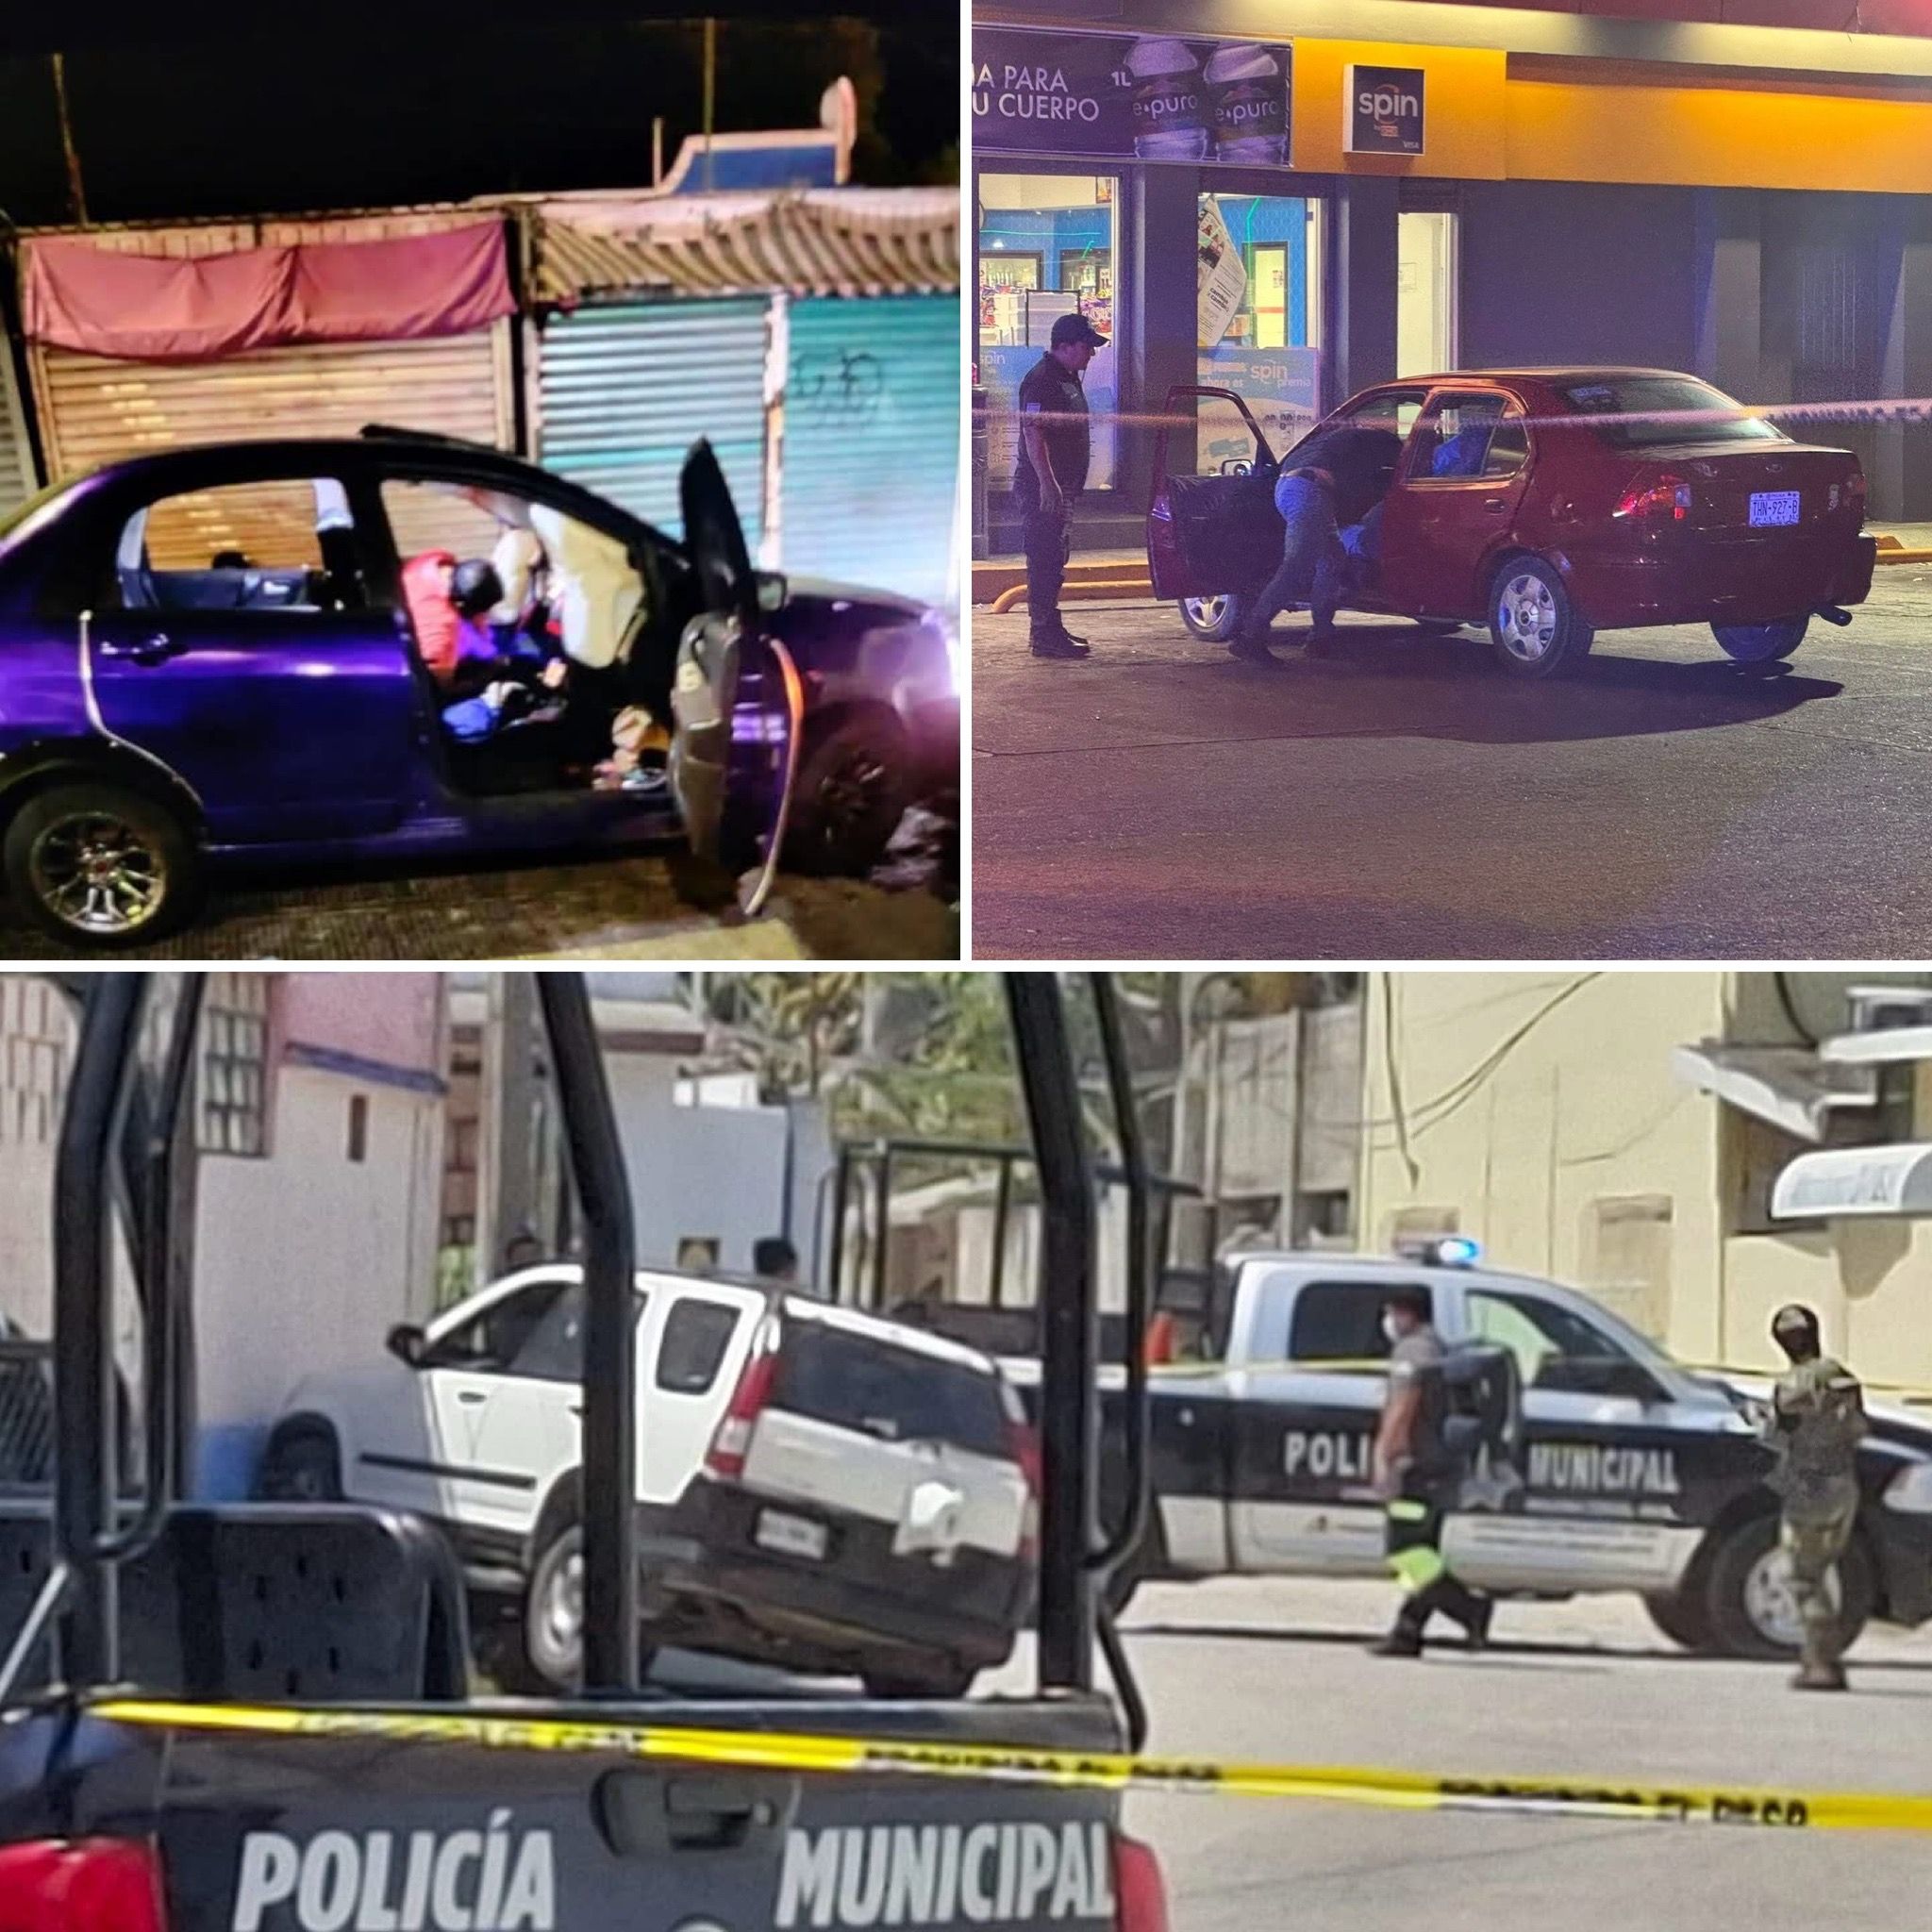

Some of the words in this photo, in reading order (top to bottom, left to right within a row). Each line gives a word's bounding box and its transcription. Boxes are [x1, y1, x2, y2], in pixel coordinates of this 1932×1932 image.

[1005, 65, 1069, 92] PARA
[1111, 71, 1132, 87] 1L
[999, 92, 1100, 122] CUERPO
[1358, 92, 1419, 121] spin
[1250, 363, 1288, 384] spin
[1284, 1432, 1371, 1477] POLI
[1529, 1443, 1680, 1493] MUNICIPAL
[232, 1807, 555, 1932] POLICÍA
[774, 1821, 1116, 1927] MUNICIPAL
